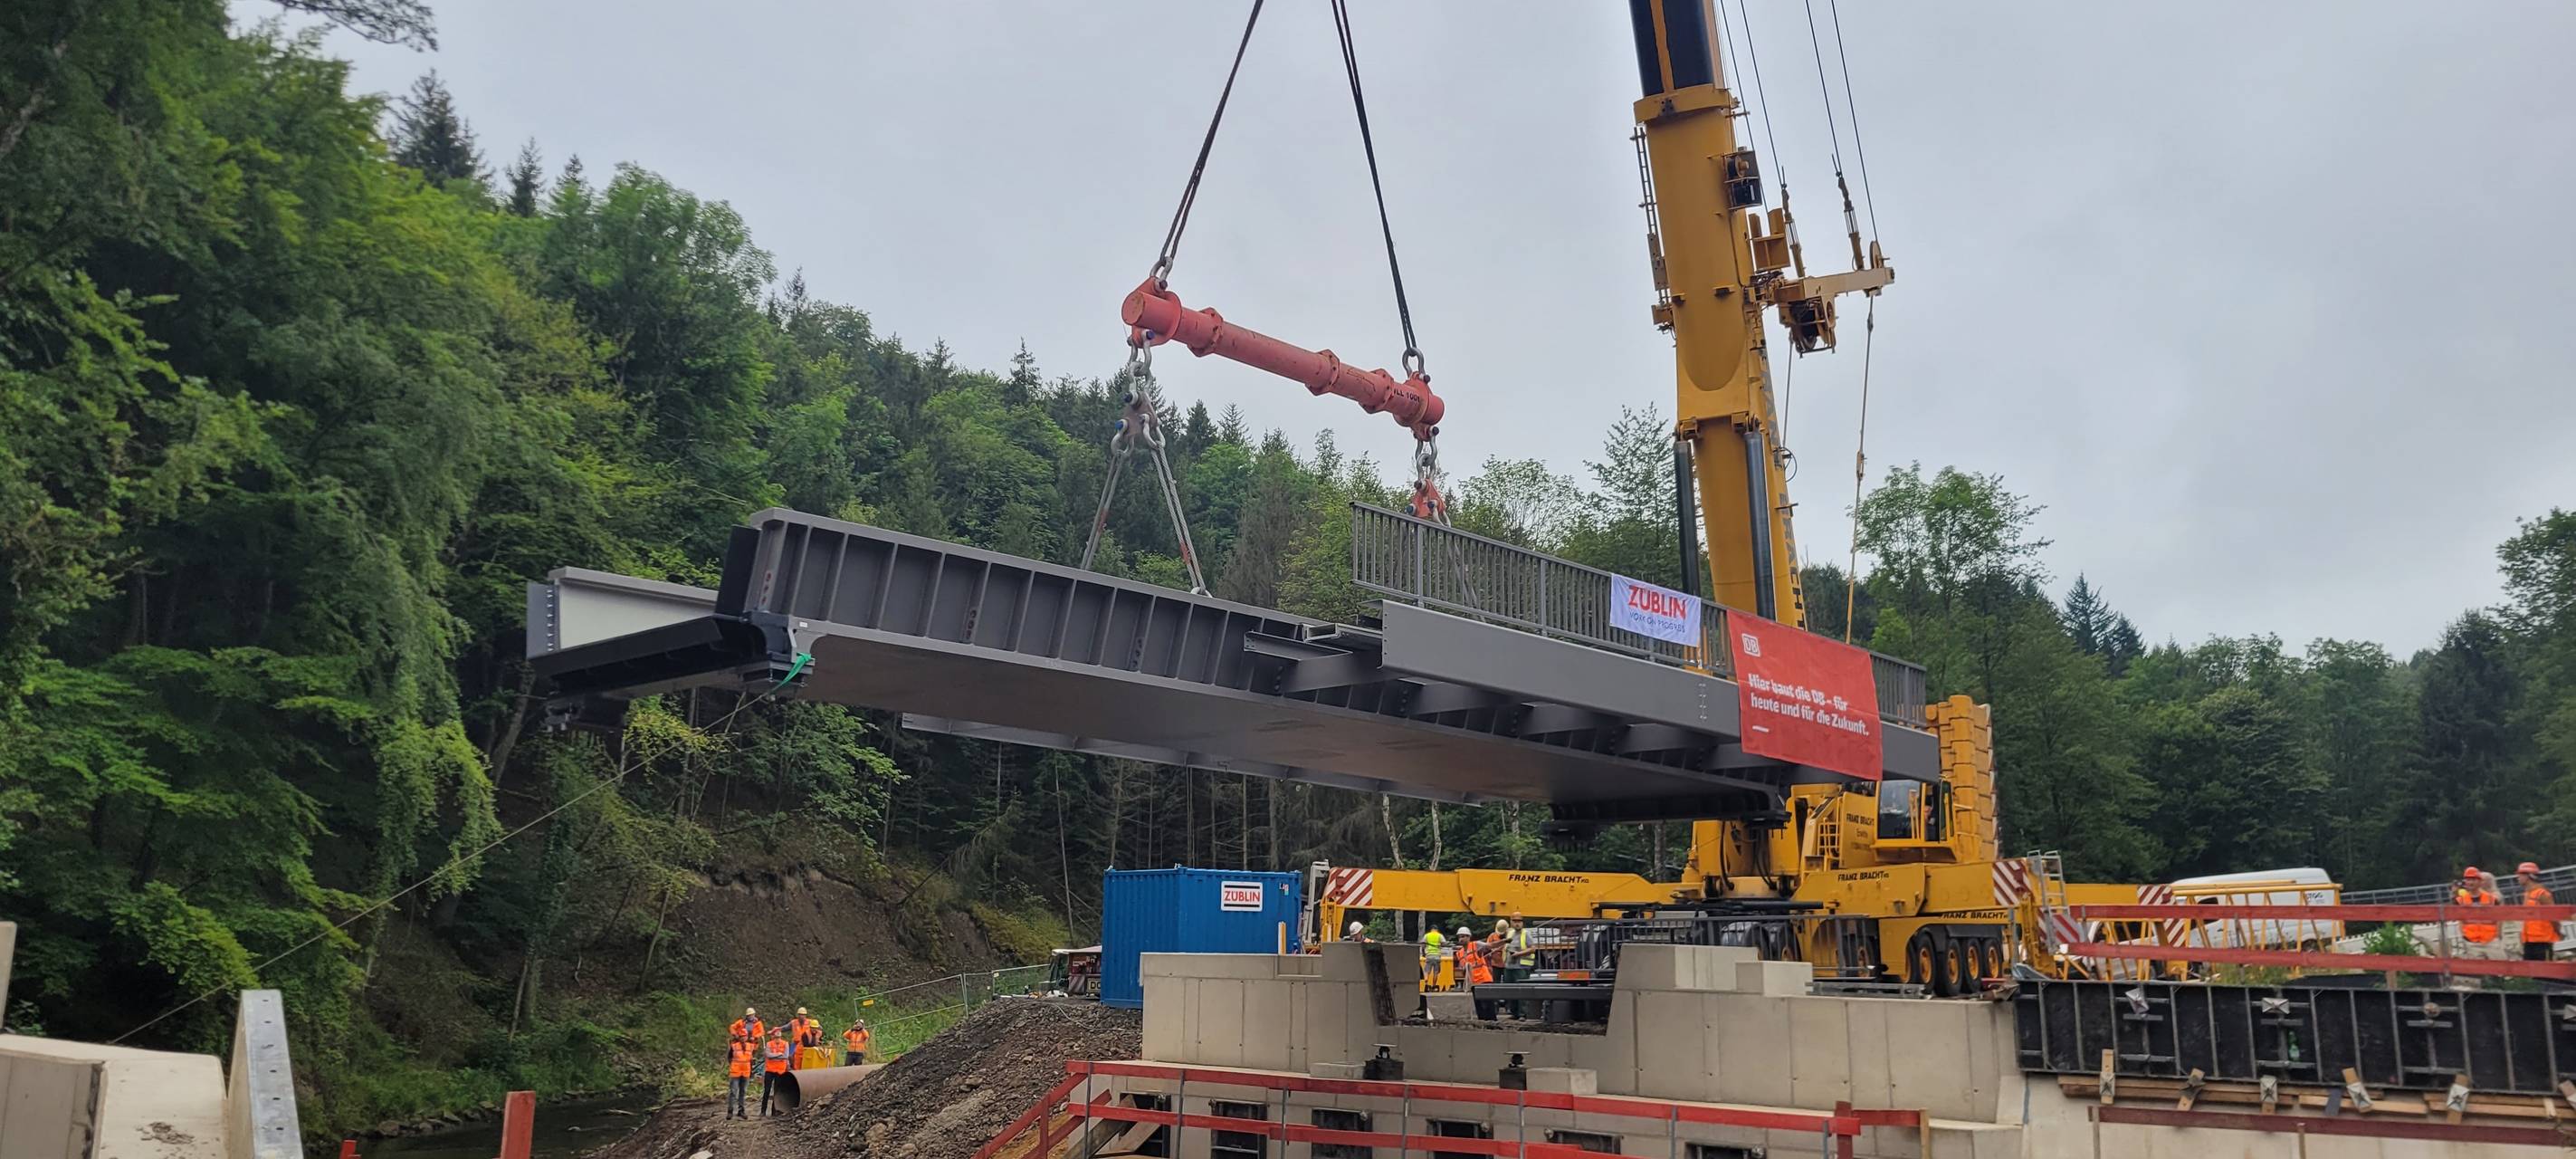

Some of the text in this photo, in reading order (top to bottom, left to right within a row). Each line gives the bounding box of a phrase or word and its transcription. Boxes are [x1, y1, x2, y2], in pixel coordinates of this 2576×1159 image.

[1627, 584, 1687, 620] ZÜBLIN
[1748, 673, 1770, 691] Hier
[1771, 680, 1794, 698] baut
[1795, 686, 1811, 702] die
[1811, 690, 1827, 706] DB
[1833, 695, 1848, 712] für
[1751, 693, 1870, 736] heute und für die Zukunft.
[1508, 875, 1541, 883] FRANZ
[1544, 875, 1582, 884] BRACHT
[1837, 873, 1857, 882] FRANZ
[1859, 870, 1884, 880] BRACHT
[1224, 890, 1260, 902] ZÜBLIN
